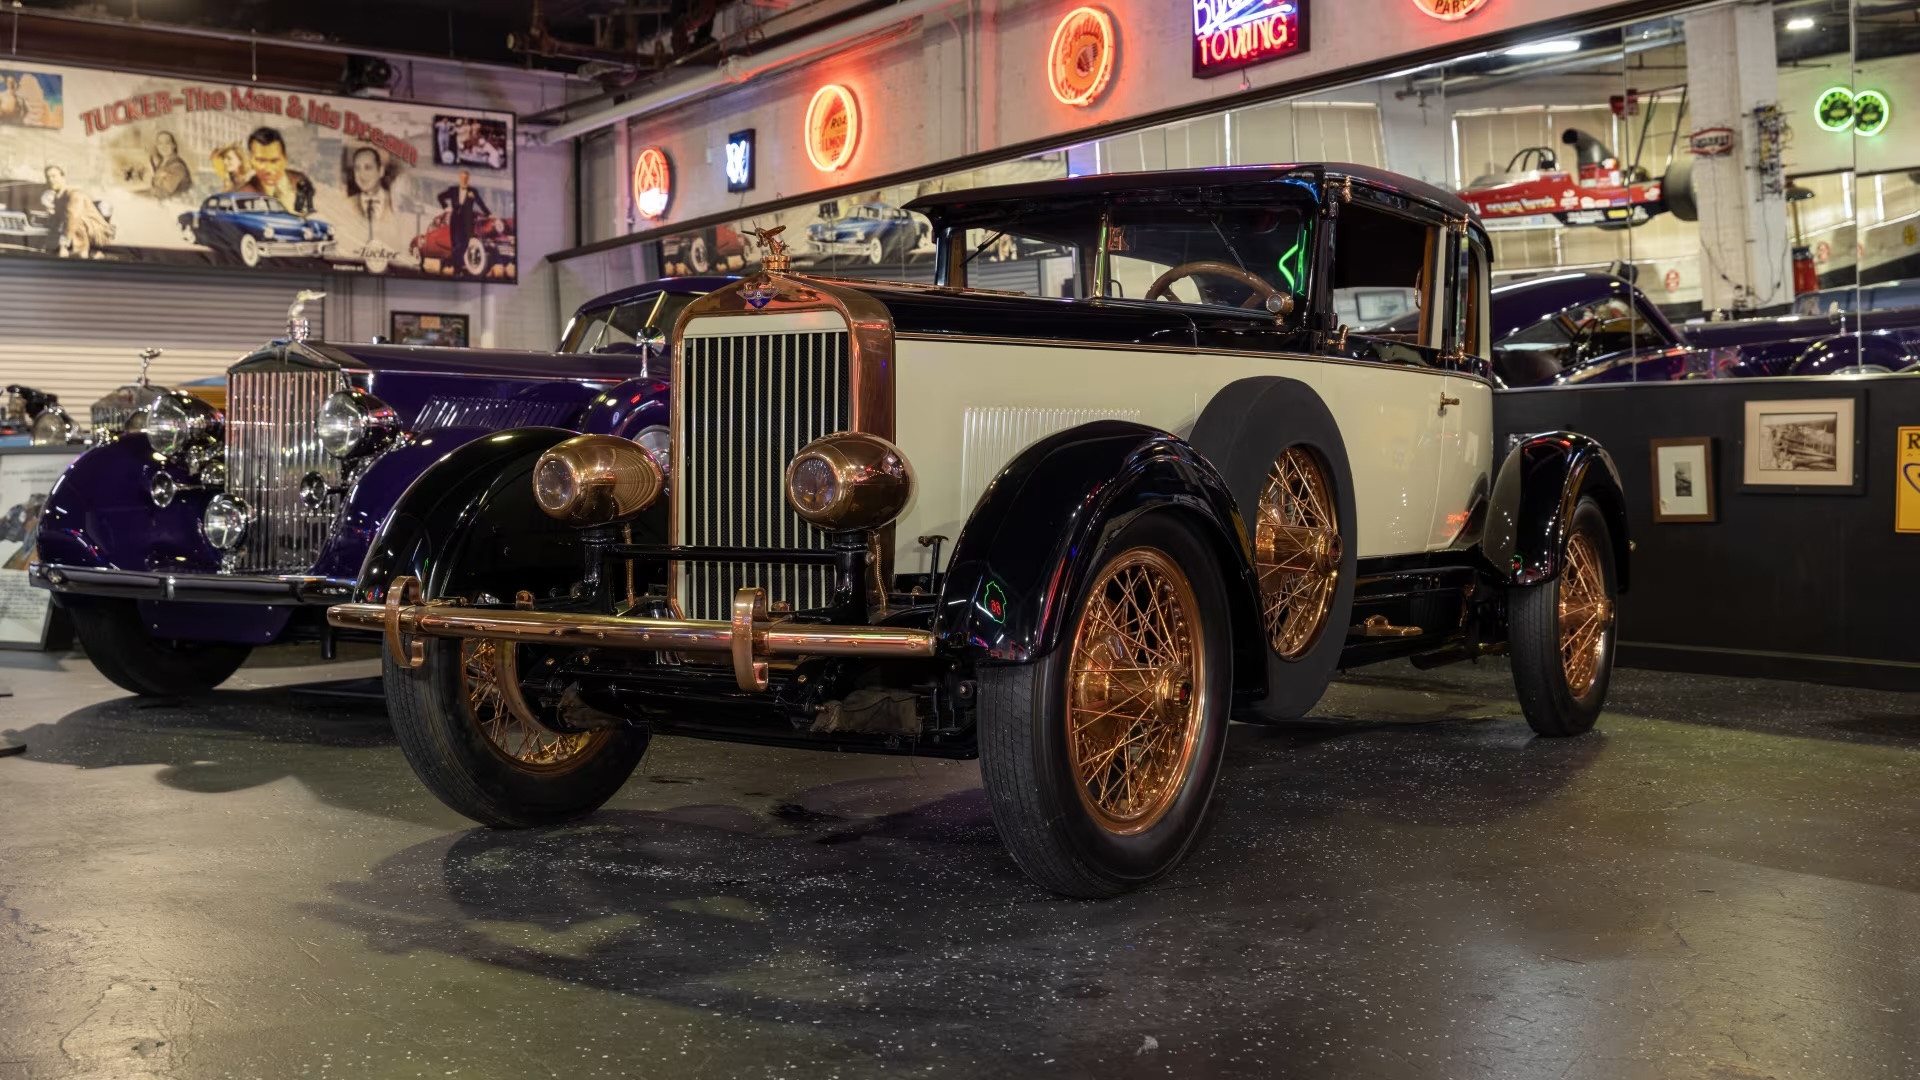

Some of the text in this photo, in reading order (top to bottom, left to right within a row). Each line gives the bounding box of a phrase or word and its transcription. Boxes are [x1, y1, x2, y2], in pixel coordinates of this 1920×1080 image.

[1197, 12, 1287, 65] TOWING
[231, 86, 282, 114] Man
[286, 95, 305, 121] &
[309, 99, 340, 130] his
[343, 110, 418, 167] Dream
